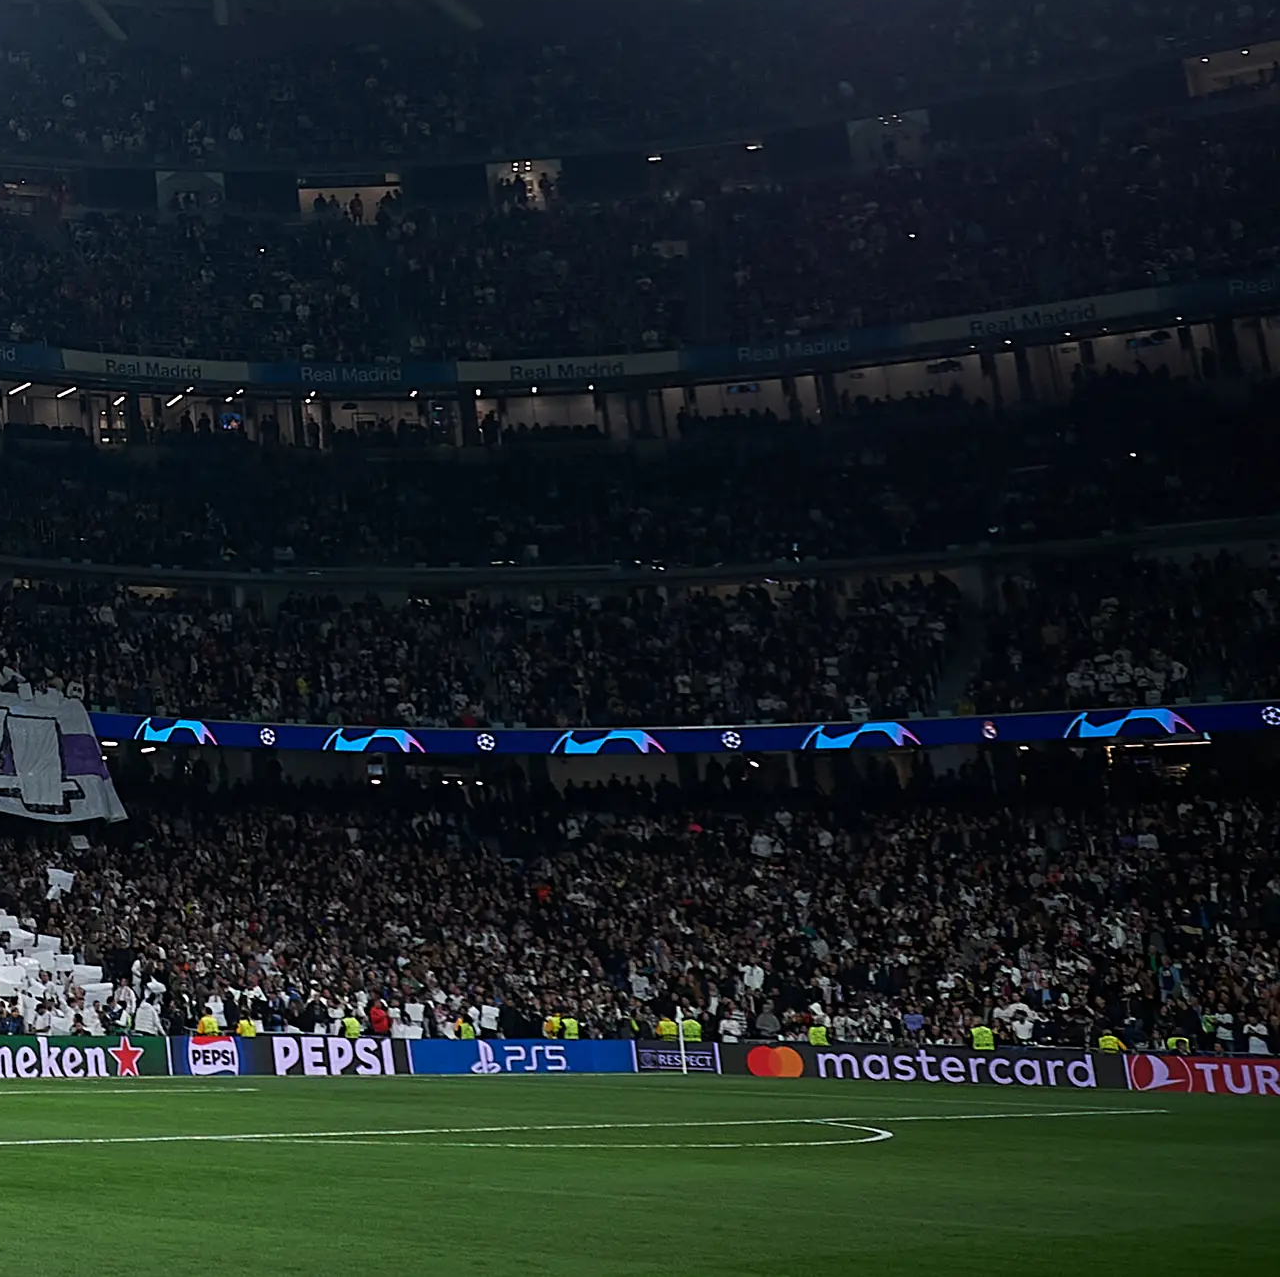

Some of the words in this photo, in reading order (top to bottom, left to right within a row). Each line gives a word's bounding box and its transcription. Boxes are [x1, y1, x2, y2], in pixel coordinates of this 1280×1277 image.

[970, 318, 1016, 336] Real
[1022, 303, 1097, 328] Madrid
[737, 344, 781, 362] Real
[789, 336, 851, 357] Madrid
[105, 359, 142, 378] Real
[145, 362, 202, 380] Madrid
[300, 366, 338, 383] Real
[342, 366, 403, 383] Madrid
[510, 364, 552, 381] Real
[557, 361, 626, 378] Madrid
[192, 1049, 236, 1067] PEPSI
[272, 1036, 396, 1076] PEPSI
[503, 1045, 567, 1071] PS5
[816, 1049, 1097, 1089] mastercard
